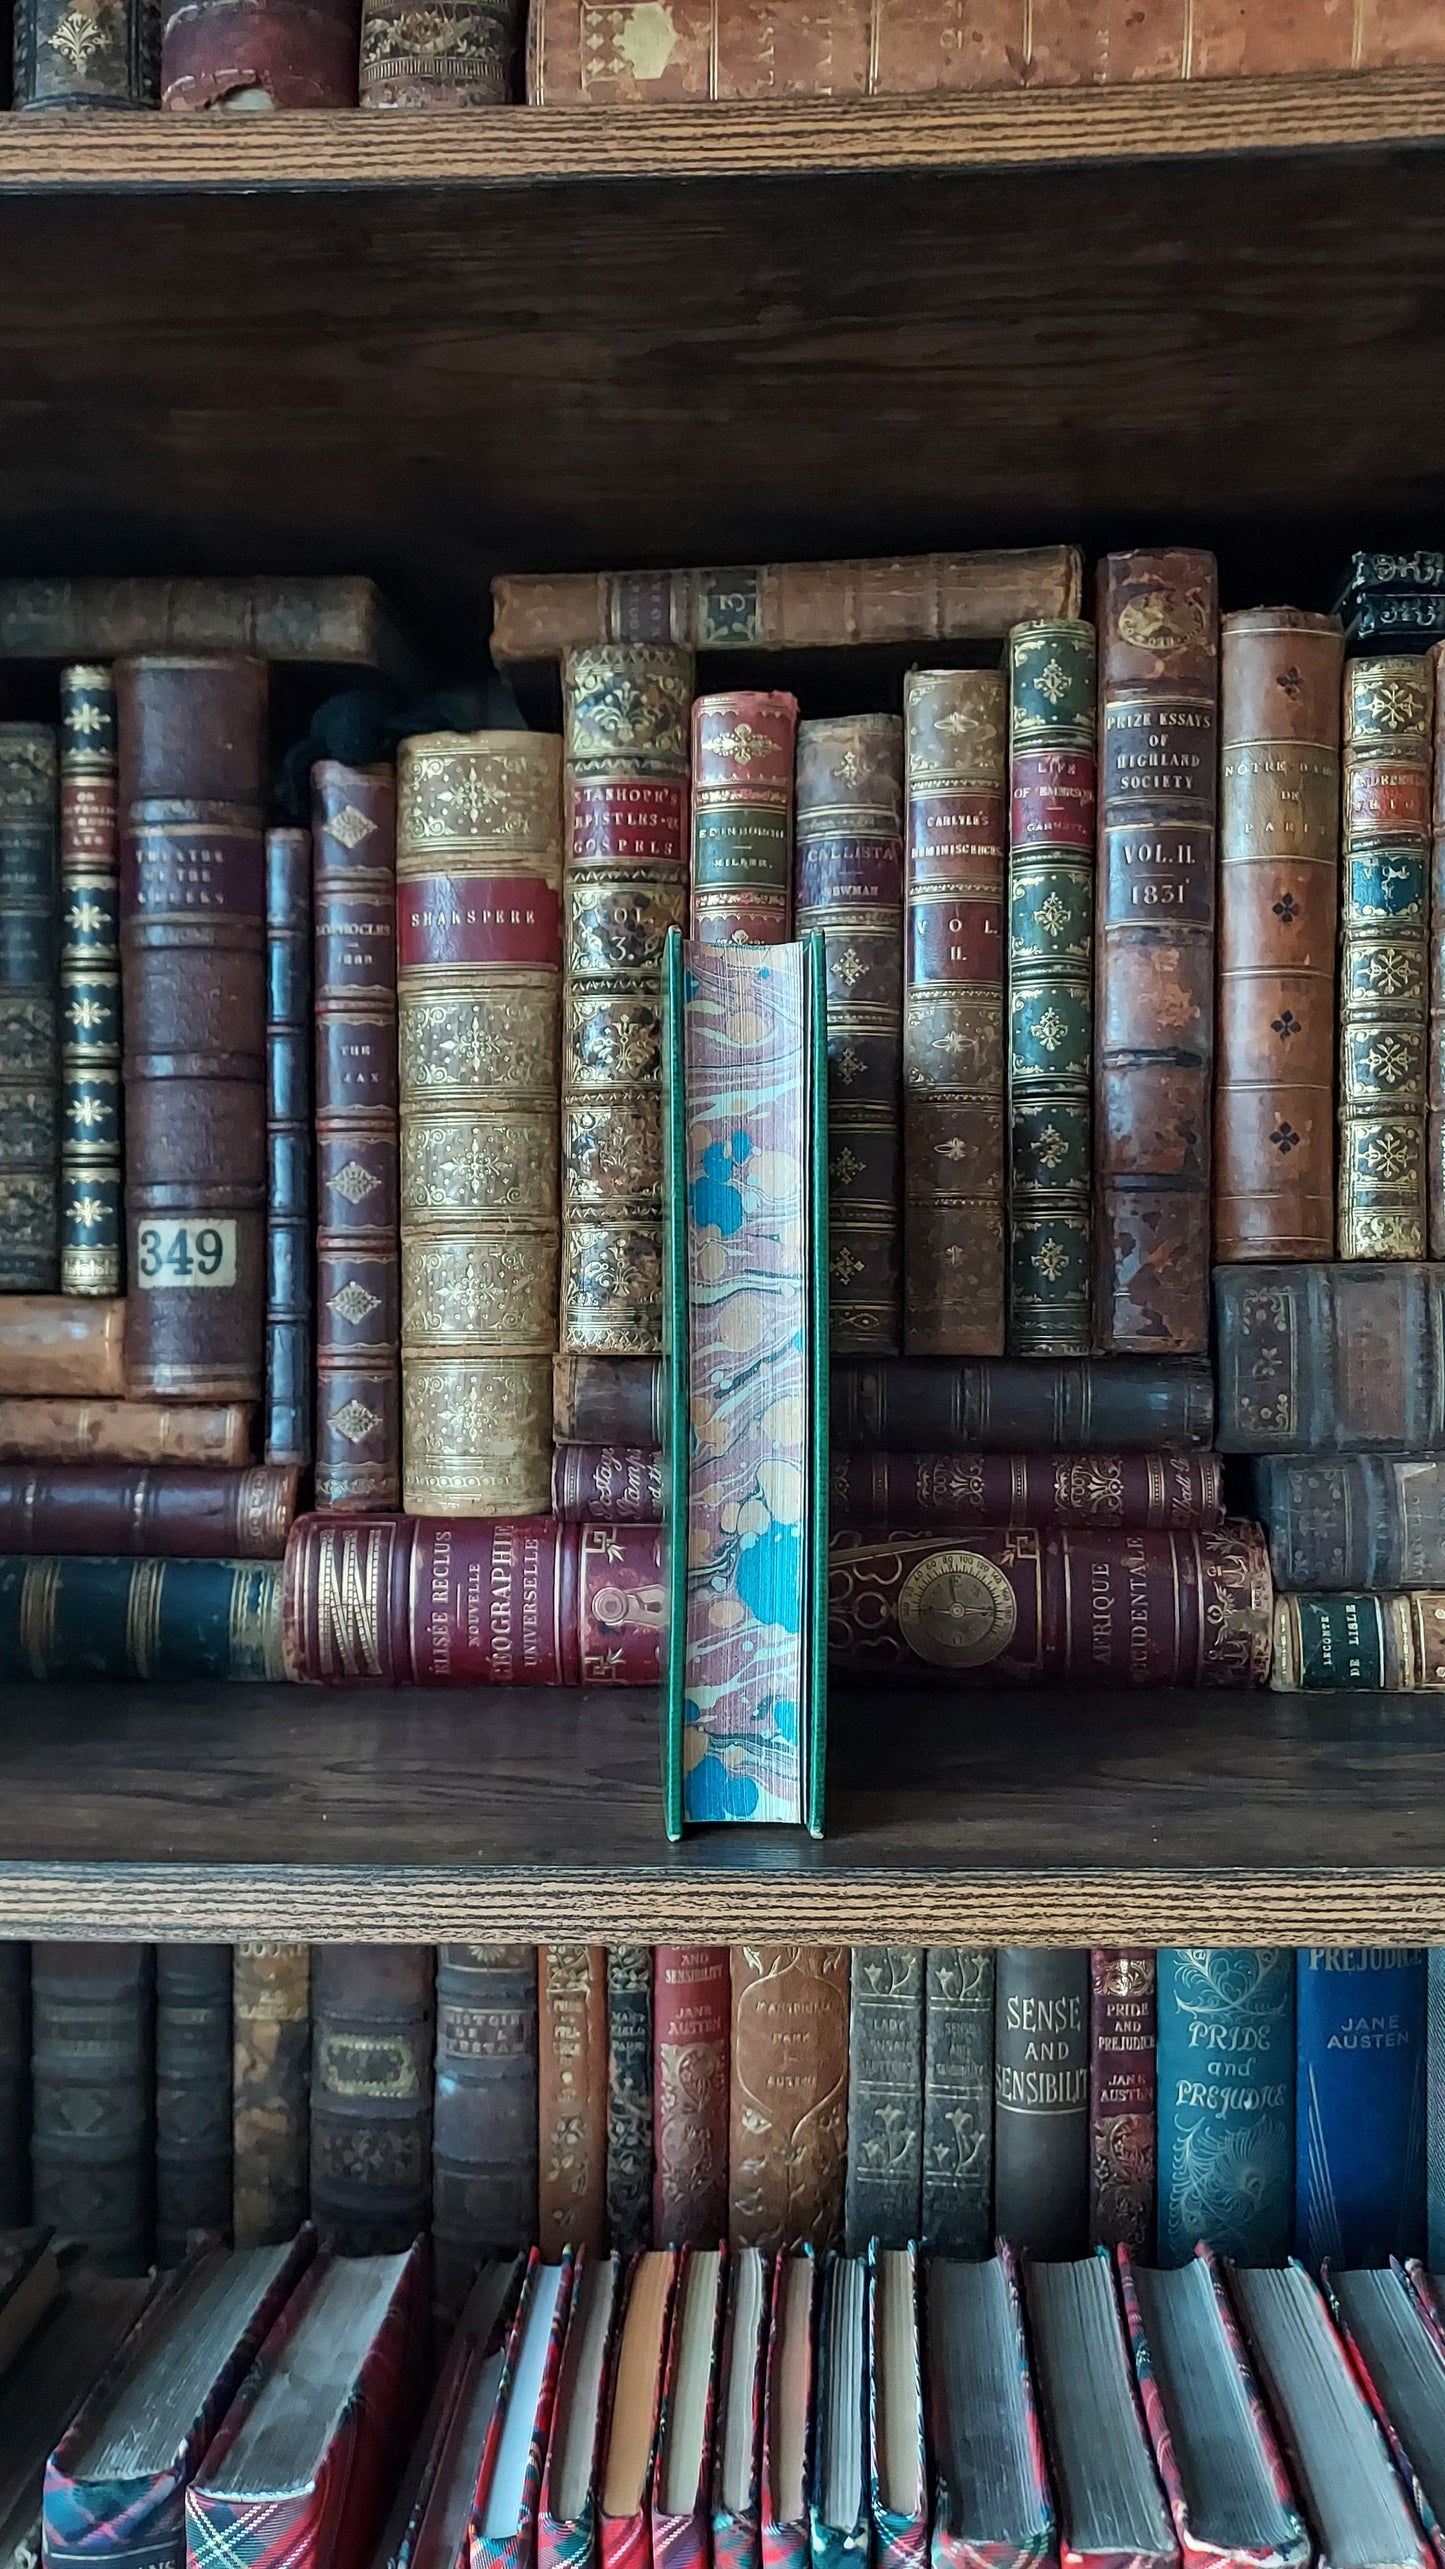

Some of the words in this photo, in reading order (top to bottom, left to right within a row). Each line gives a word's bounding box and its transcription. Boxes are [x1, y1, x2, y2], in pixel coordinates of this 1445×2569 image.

[1106, 712, 1151, 730] PRIZE
[1159, 711, 1211, 728] ESSAYS
[1149, 734, 1169, 747] OF
[1116, 753, 1201, 769] HIGHLAND
[1224, 762, 1287, 777] NOTRE
[1013, 786, 1031, 799] OF
[1120, 775, 1194, 791] SOCIETY
[573, 839, 673, 855] GOSPELS
[807, 847, 894, 863] CALLISTA
[1123, 845, 1173, 865] VOL.
[1131, 885, 1185, 904] 1831
[410, 909, 535, 927] SHAKSPERE
[916, 918, 998, 936] VOL.
[609, 936, 635, 962] 3.
[950, 946, 968, 961] II.
[141, 1228, 223, 1276] 349
[589, 1447, 623, 1520] Postage
[432, 1531, 452, 1604] RECLUS
[468, 1563, 481, 1647] NOUVELLE
[486, 1525, 515, 1680] GÉOGRAPHIE
[523, 1538, 539, 1667] UNIVERSELLE
[1126, 1537, 1150, 1681] CCIDENTALE
[1091, 1563, 1115, 1665] AFRIQUE
[1345, 1604, 1360, 1646] LISLE
[427, 1612, 449, 1676] ÉLISÉE
[1320, 1615, 1333, 1666] LECONTE
[1349, 1658, 1360, 1677] DE
[681, 1952, 709, 1967] AND
[1308, 1948, 1422, 1972] PREJUDICE
[675, 2005, 712, 2020] JANE
[1006, 1995, 1081, 2033] SENSE
[1106, 2002, 1149, 2017] PRIDE
[667, 2016, 722, 2036] AUSTEN
[873, 2018, 906, 2031] LADY
[1114, 2021, 1142, 2033] AND
[1341, 2015, 1401, 2032] JANE
[1098, 2036, 1156, 2051] PREJUDICE
[1187, 2021, 1271, 2050] PRIDE
[1326, 2031, 1410, 2050] AUSTEN
[1024, 2041, 1070, 2062] AND
[1207, 2057, 1256, 2077] and
[996, 2064, 1088, 2106] ENSIBILIT
[1108, 2073, 1146, 2086] JANE
[1100, 2088, 1153, 2102] AUSTEN
[1175, 2079, 1287, 2119] PREJUDICE
